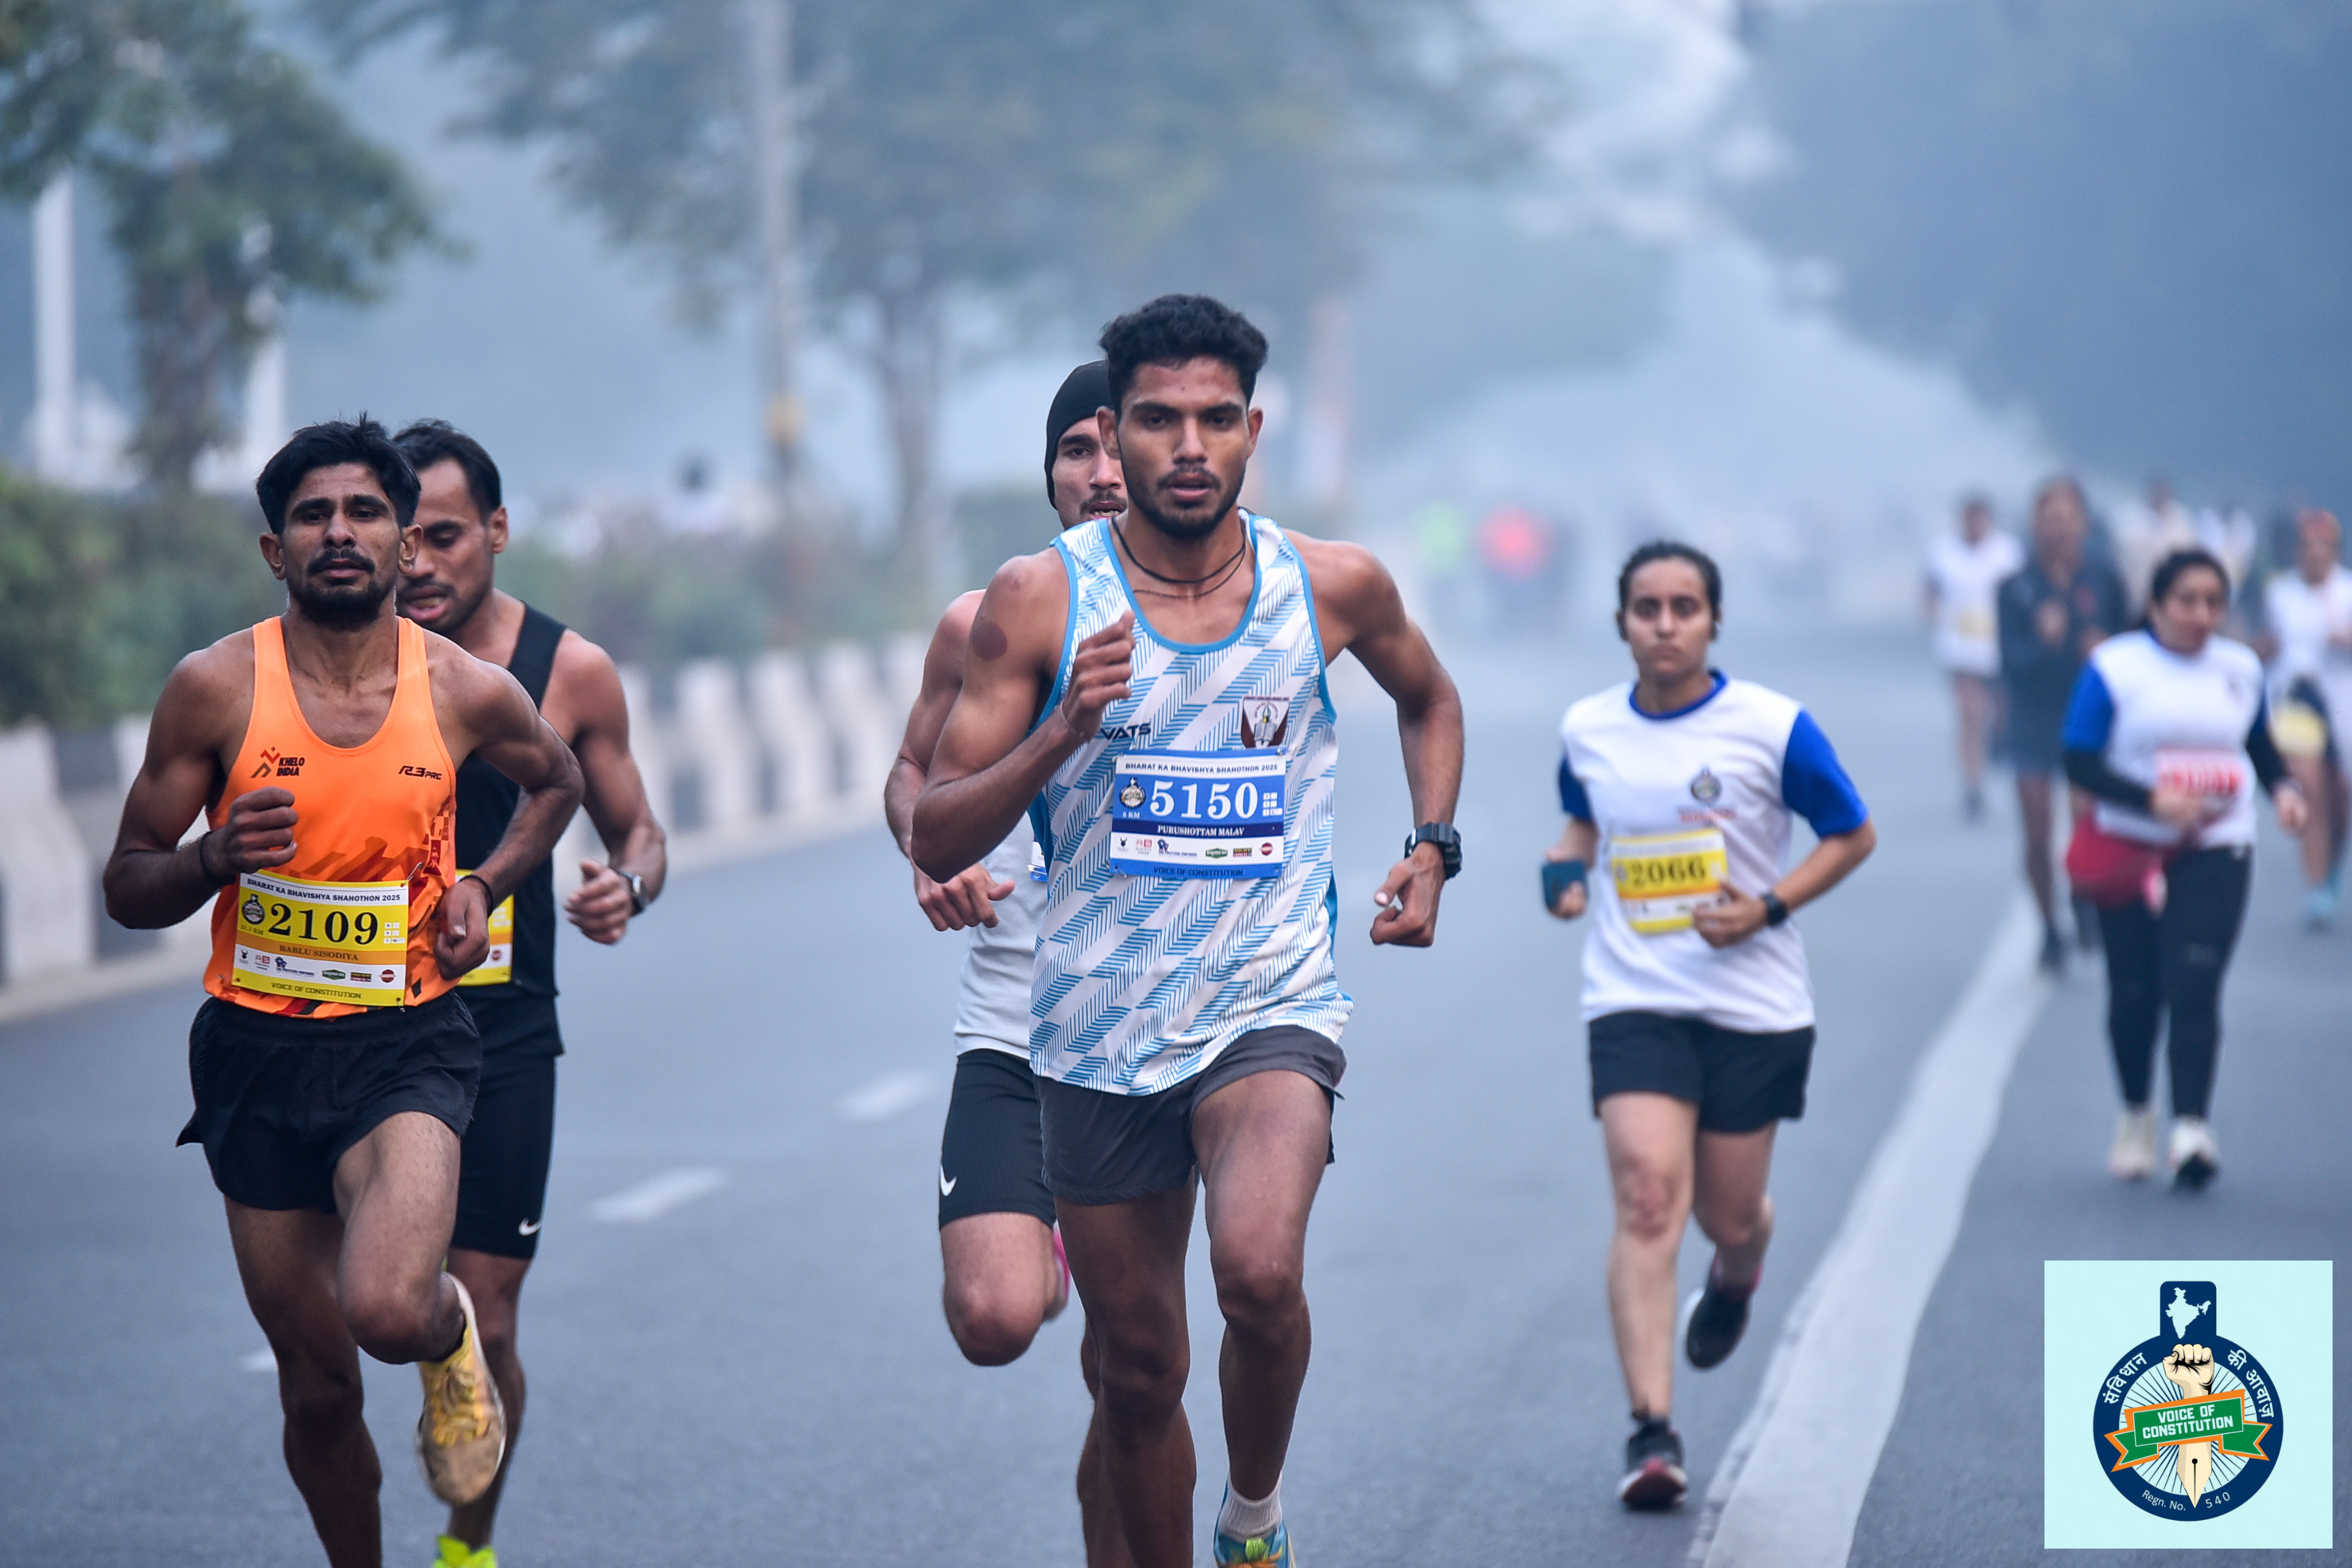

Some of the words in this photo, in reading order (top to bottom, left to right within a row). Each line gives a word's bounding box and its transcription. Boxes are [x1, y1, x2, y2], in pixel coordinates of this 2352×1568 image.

[1100, 723, 1151, 740] VATS
[279, 757, 305, 767] KHELO
[1170, 765, 1214, 773] BHAVISHYA
[276, 767, 299, 776] INDIA
[1150, 780, 1258, 820] 5150
[1158, 824, 1217, 837] PURUSHOTTAM
[1218, 826, 1244, 837] MALAV
[1153, 866, 1174, 875] VOICE
[1177, 867, 1185, 875] OF
[1188, 868, 1243, 877] CONSTITUTION
[247, 878, 274, 891] BHARAT
[276, 886, 286, 894] KA
[287, 889, 330, 900] BHAVISHYA
[269, 903, 378, 945] 2109
[280, 945, 311, 956] BABLU
[313, 950, 358, 961] SISODIYA
[271, 982, 293, 991] VOICE
[305, 987, 362, 999] CONSTITUTION
